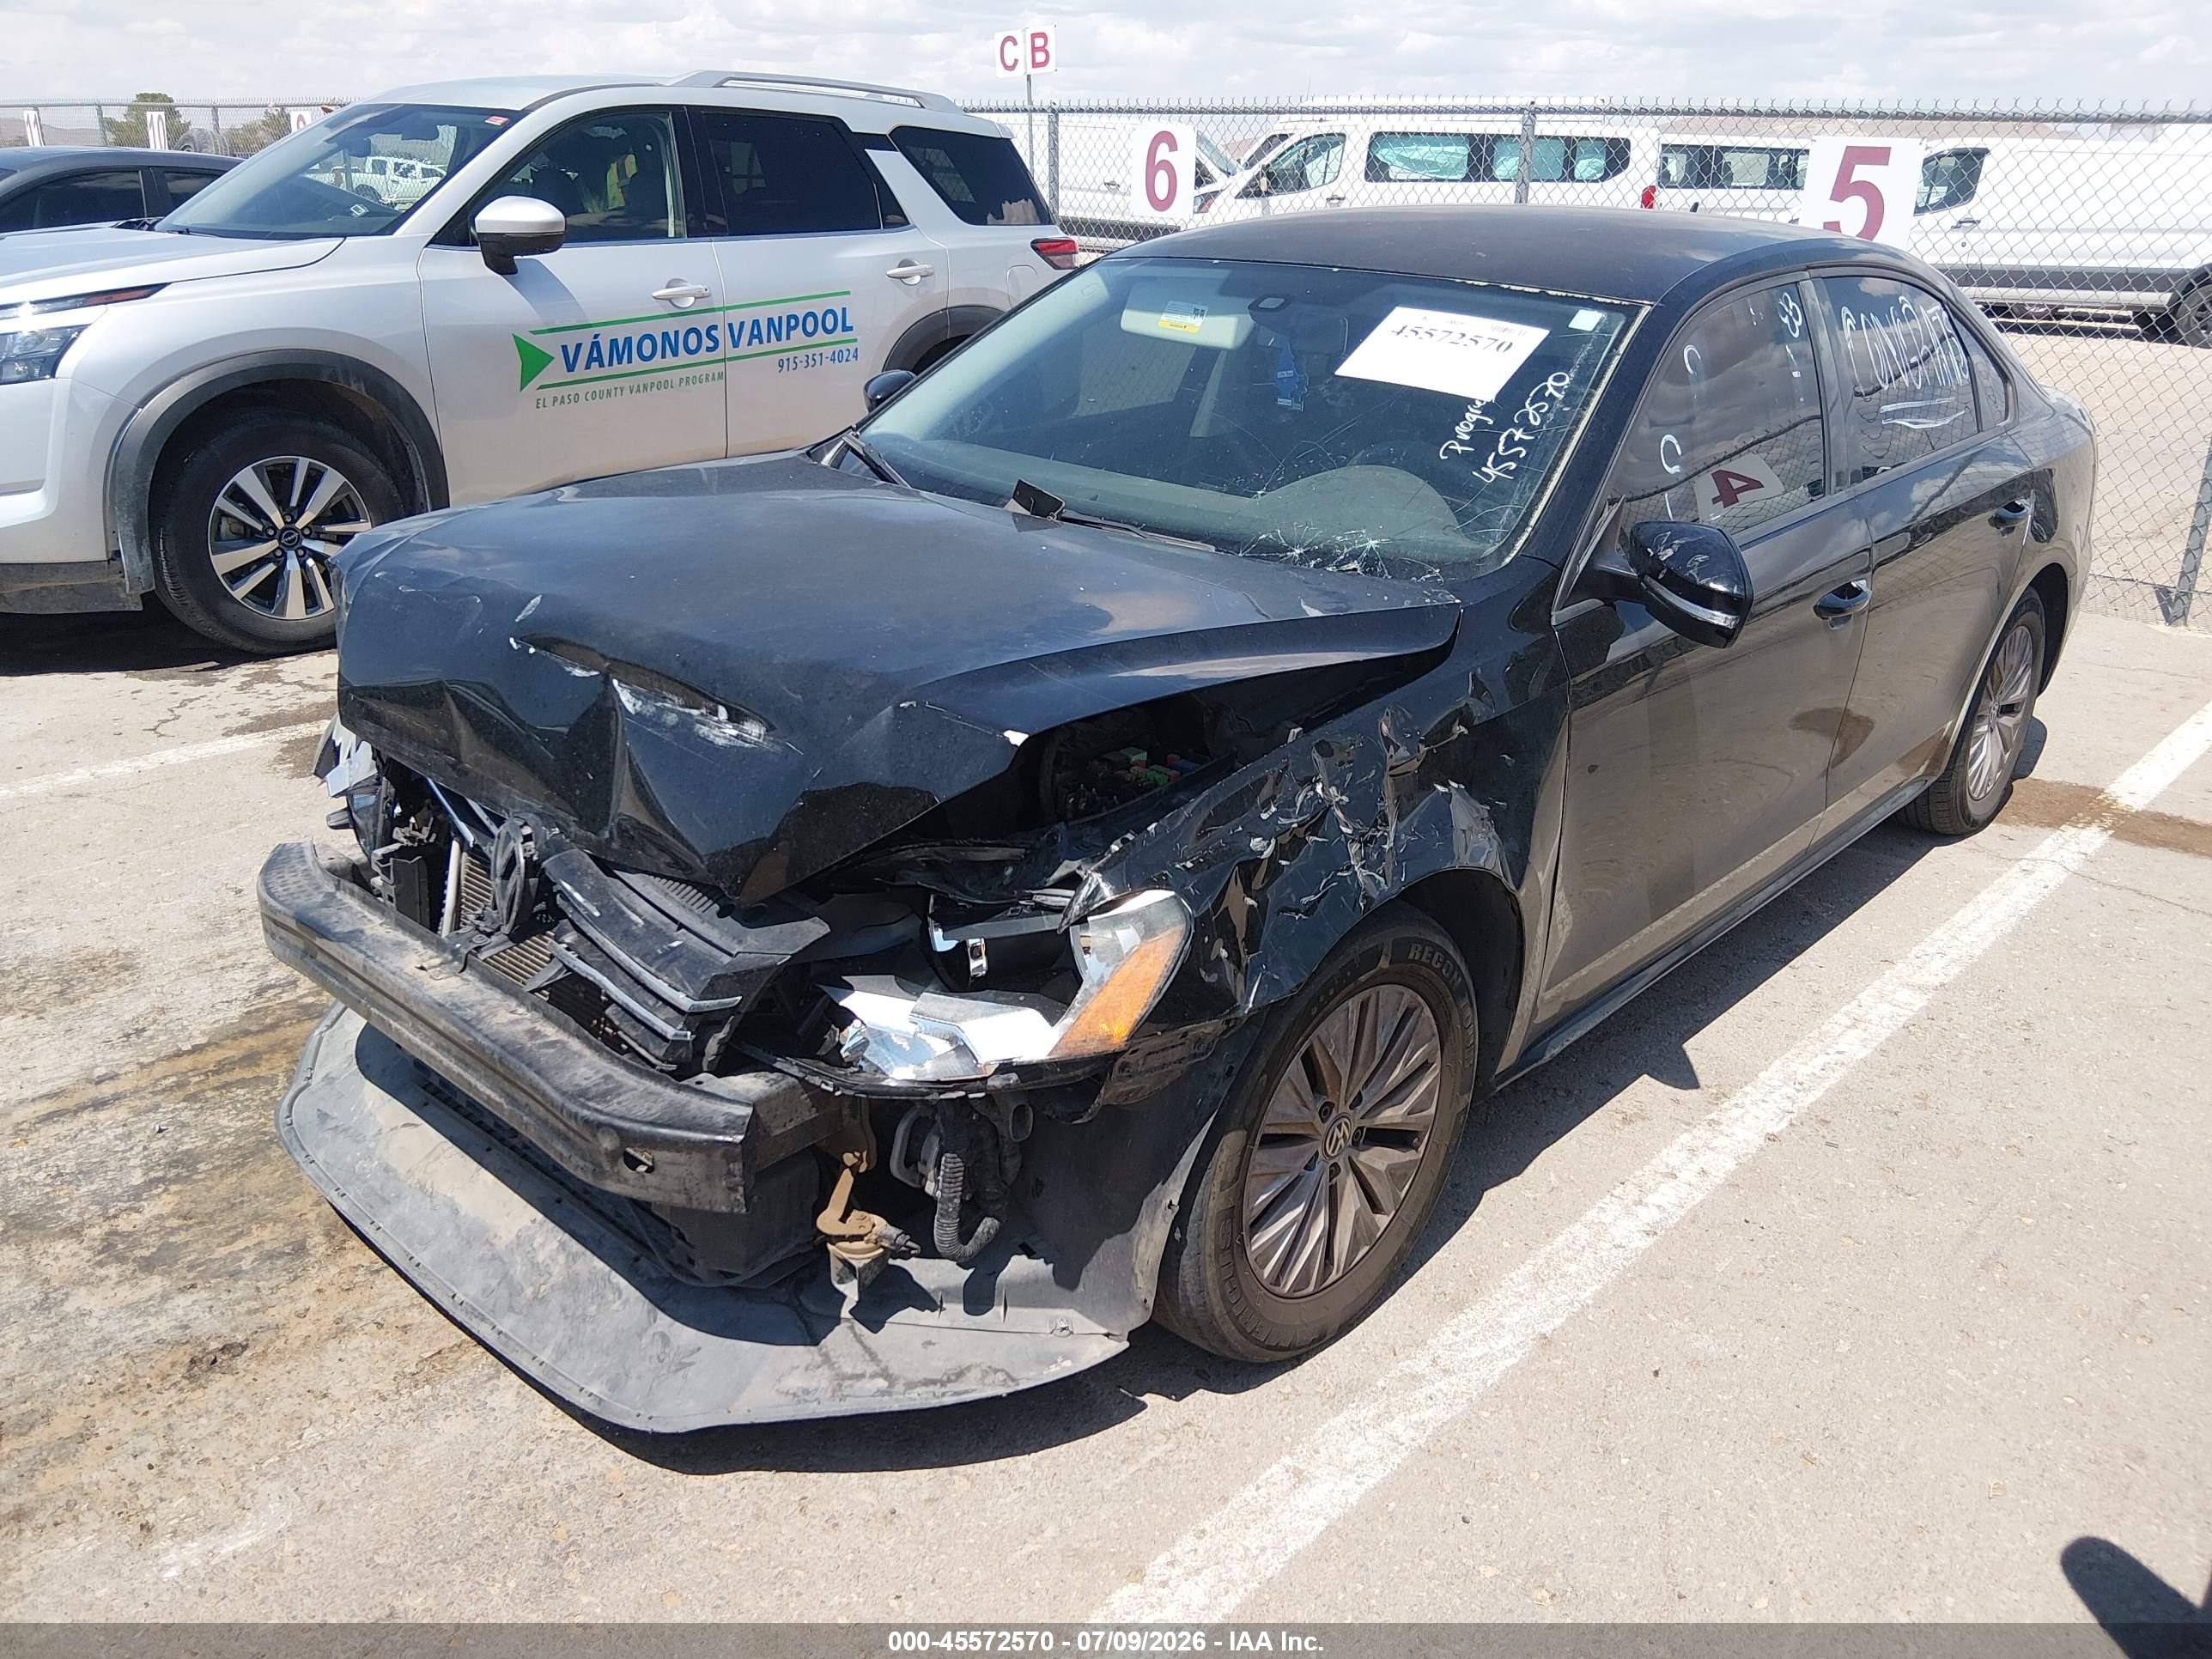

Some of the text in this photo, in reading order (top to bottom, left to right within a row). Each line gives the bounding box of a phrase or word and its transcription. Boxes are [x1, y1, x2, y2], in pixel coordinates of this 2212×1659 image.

[1000, 35, 1018, 72] C
[1030, 32, 1050, 69] B
[149, 114, 168, 150] 10
[1145, 130, 1178, 212] 6
[1822, 145, 1892, 241] 5
[561, 307, 854, 373] VÁMONOS VANPOOL
[1390, 323, 1513, 354] 45572570
[778, 347, 859, 373] 915-351-4024
[536, 371, 724, 410] EL PASO COUNTY VANPOOL PROGRAM
[1472, 371, 1571, 483] 45572570
[1407, 943, 1462, 989] RECON
